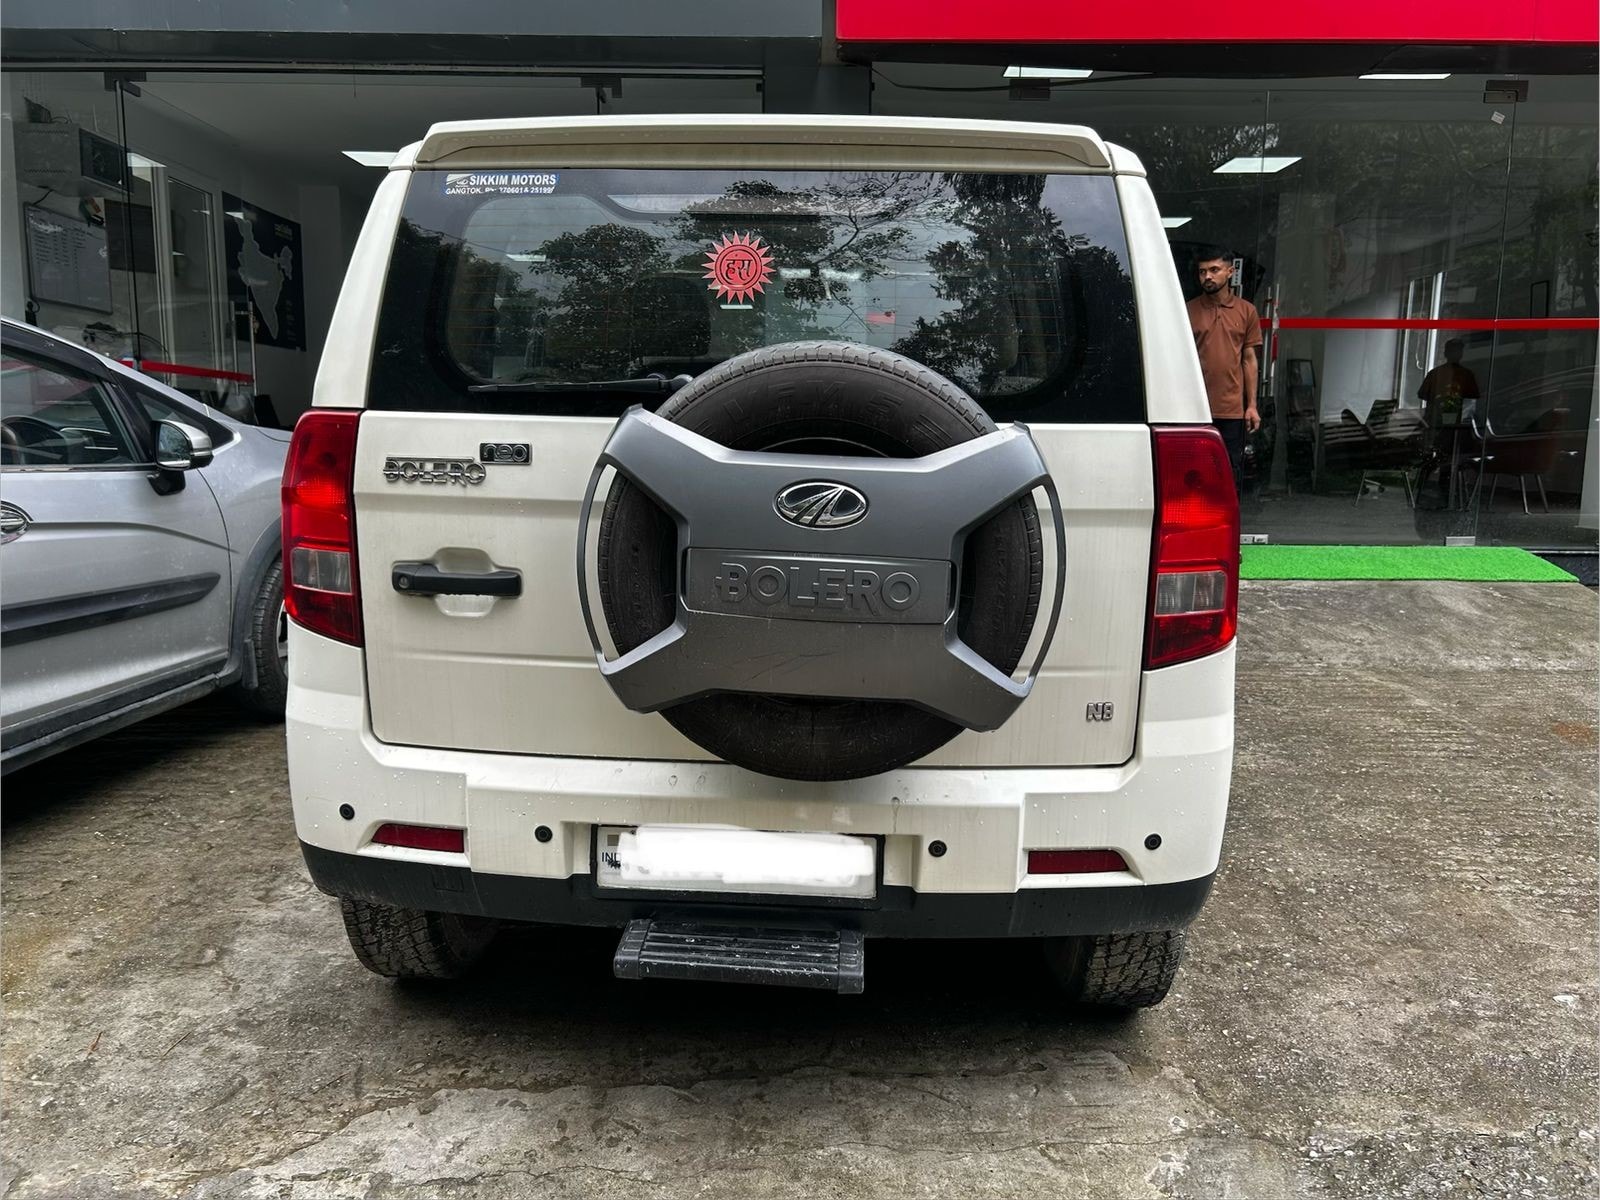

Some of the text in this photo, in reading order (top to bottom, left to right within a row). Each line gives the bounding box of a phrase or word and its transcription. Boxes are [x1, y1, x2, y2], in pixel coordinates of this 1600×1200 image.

[469, 174, 557, 185] SIKKIM MOTORS
[382, 457, 487, 488] BOLERO
[715, 562, 921, 616] BOLERO
